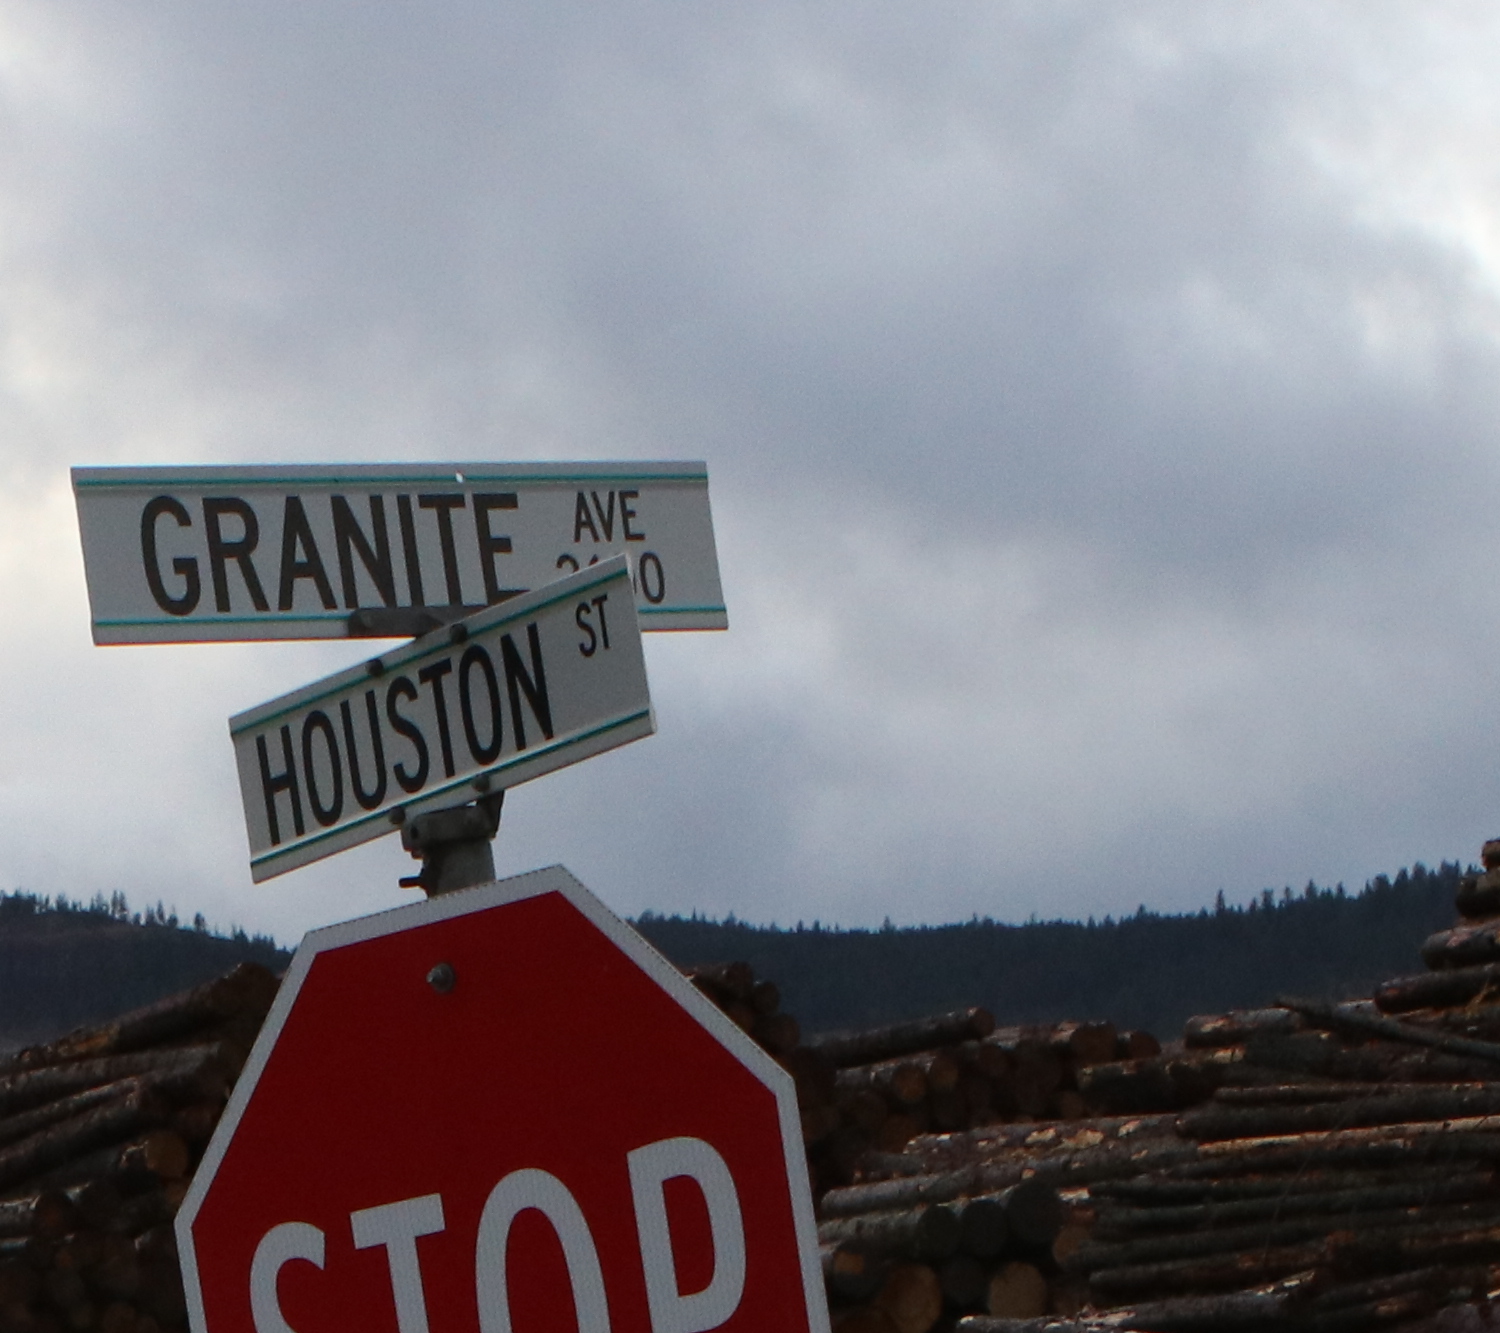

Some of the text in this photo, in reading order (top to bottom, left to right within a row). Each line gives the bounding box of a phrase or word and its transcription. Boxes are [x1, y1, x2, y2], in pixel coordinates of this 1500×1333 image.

[140, 492, 530, 616] GRANITE
[573, 489, 645, 542] AVE
[256, 594, 611, 845] HOUSTON ST
